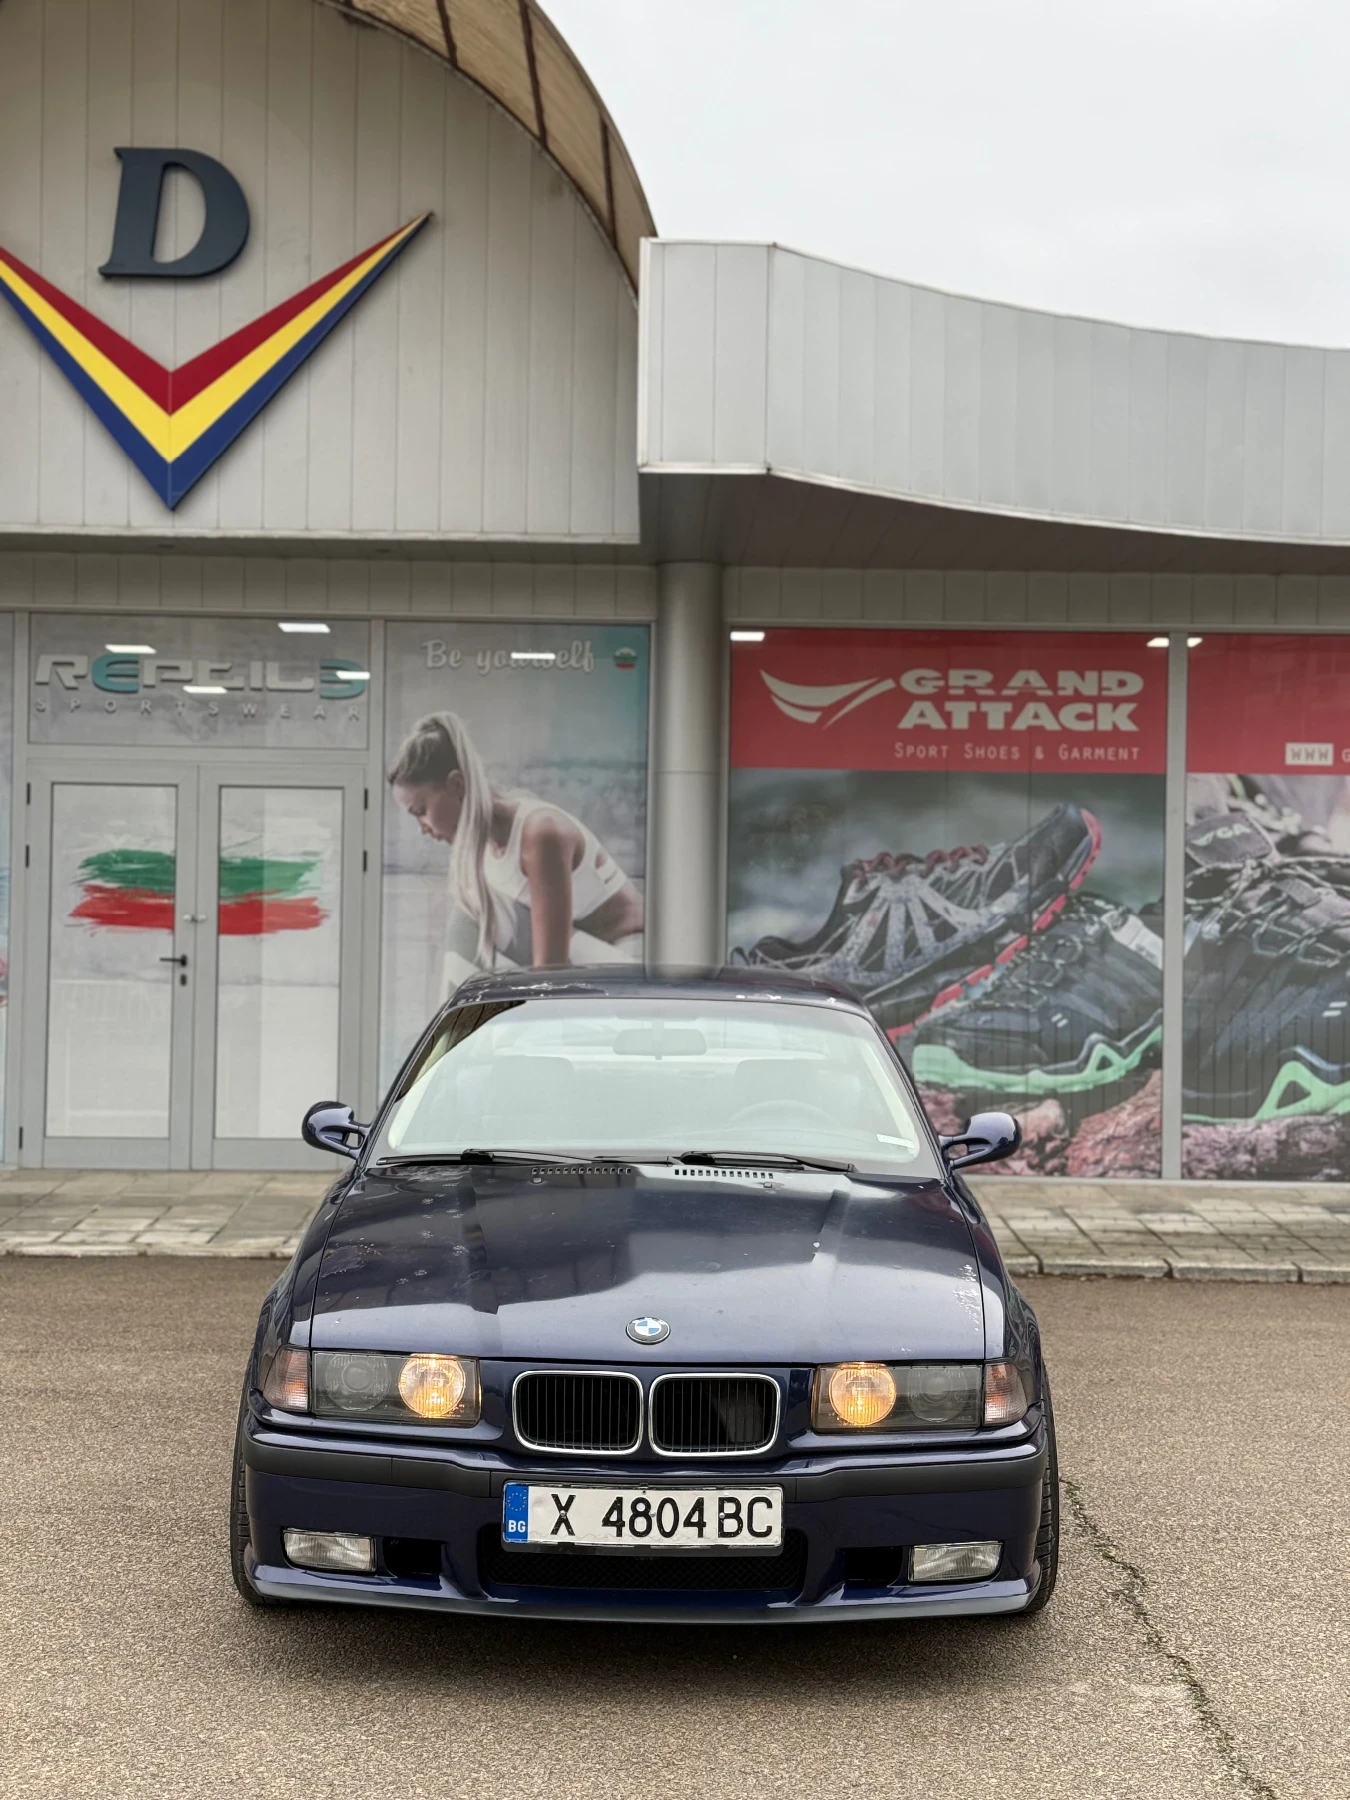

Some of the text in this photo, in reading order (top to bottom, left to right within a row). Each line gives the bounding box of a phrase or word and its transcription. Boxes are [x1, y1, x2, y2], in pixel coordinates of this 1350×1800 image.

[98, 147, 250, 278] D
[421, 639, 596, 675] Be yourself
[899, 668, 1145, 697] GRAND
[35, 699, 361, 723] SPORTSWEAR
[897, 700, 1140, 732] ATTACK
[1034, 745, 1046, 761] &
[508, 1519, 526, 1533] BG
[550, 1493, 773, 1539] X 4804 BC
